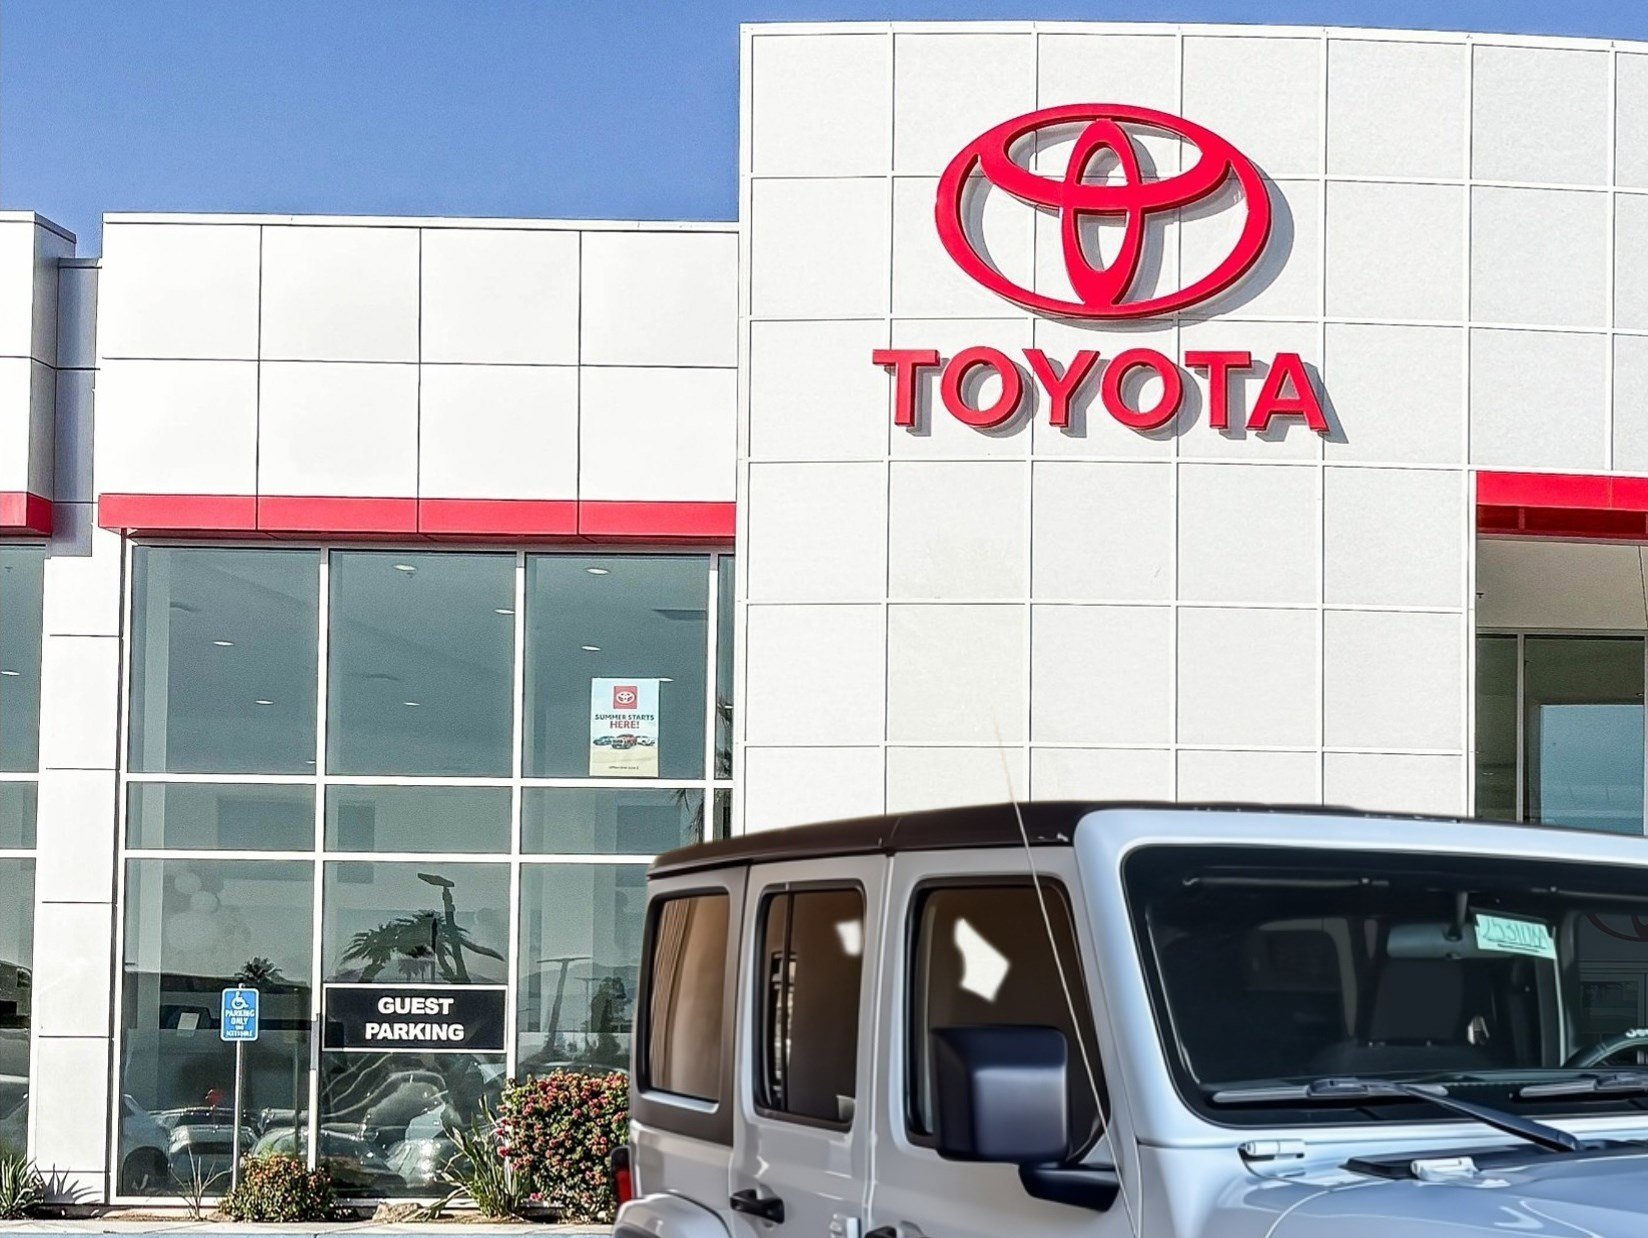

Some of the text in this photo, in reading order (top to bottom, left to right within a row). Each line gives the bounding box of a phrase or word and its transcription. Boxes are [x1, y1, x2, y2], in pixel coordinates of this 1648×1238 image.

[873, 346, 1330, 432] TOYOTA
[610, 721, 639, 729] HERE!
[377, 997, 454, 1015] GUEST
[365, 1023, 464, 1041] PARKING
